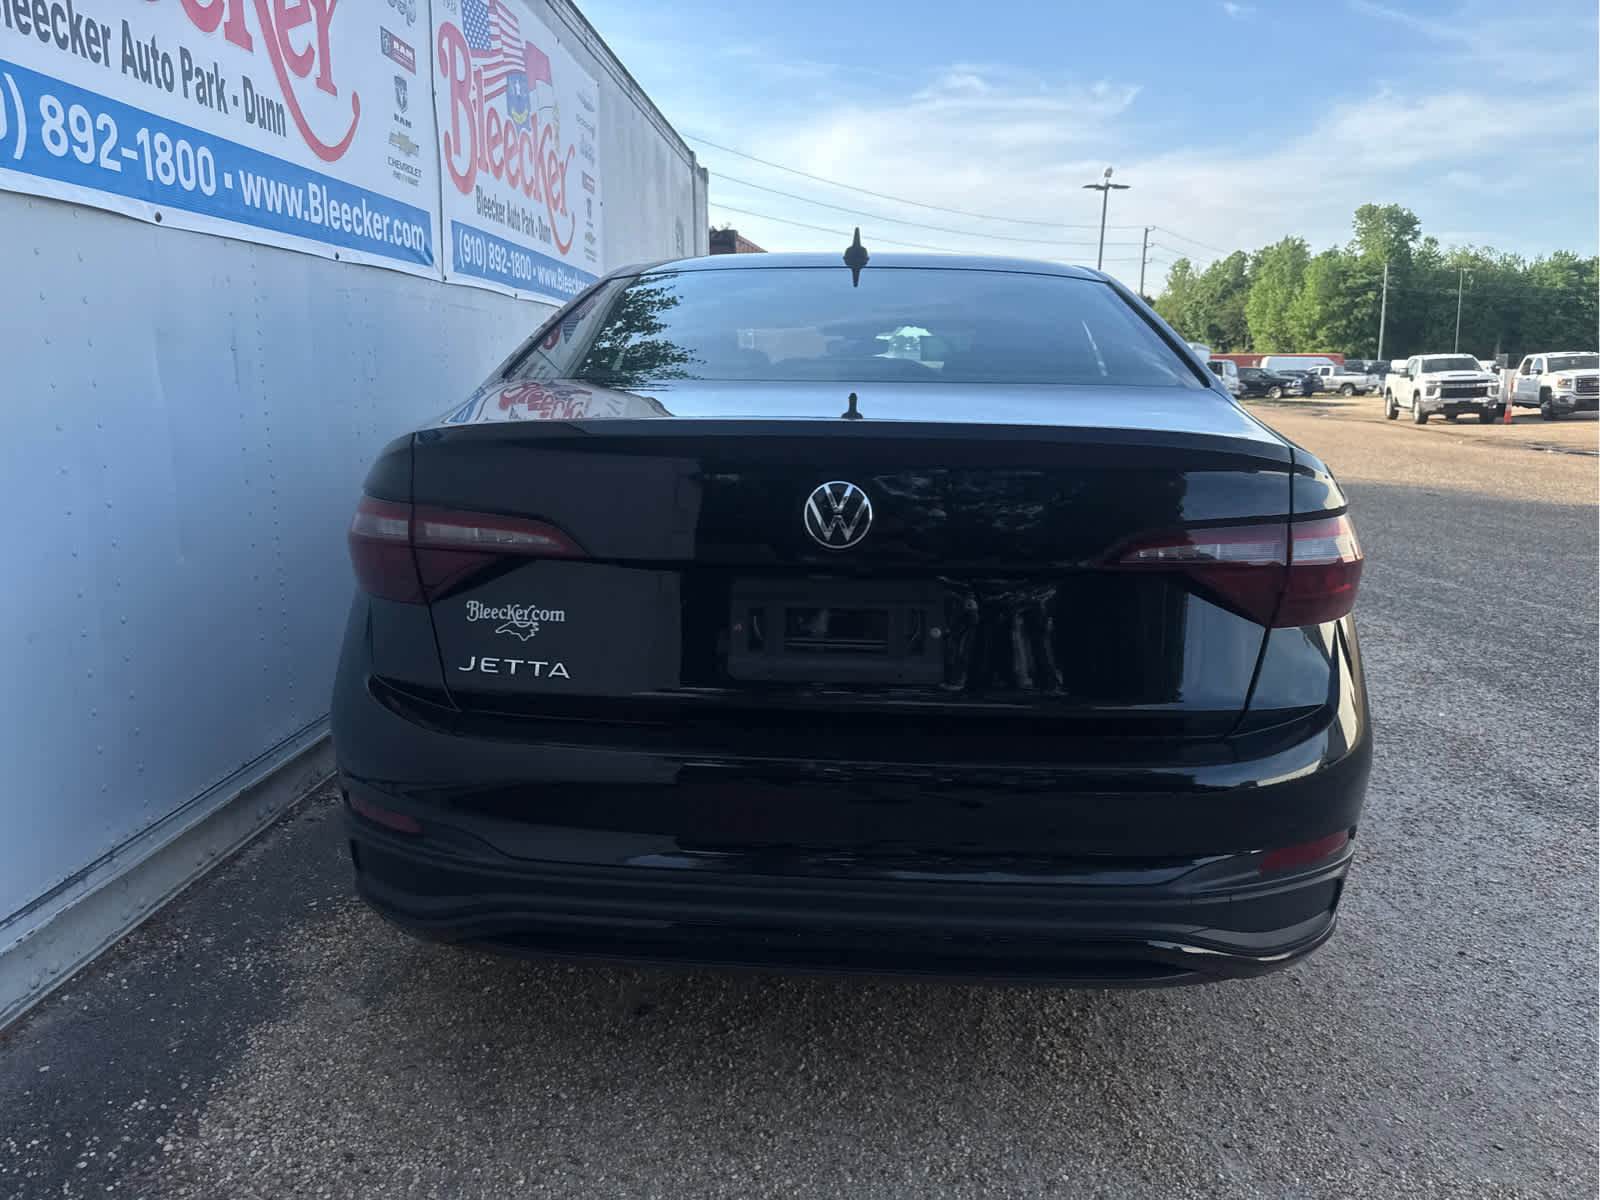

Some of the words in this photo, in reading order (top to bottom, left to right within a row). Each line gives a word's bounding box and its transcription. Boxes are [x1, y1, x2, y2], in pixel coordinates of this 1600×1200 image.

[121, 19, 175, 93] Auto
[179, 46, 229, 115] Park
[242, 75, 287, 138] Dunn
[39, 94, 218, 197] 892-1800
[238, 169, 425, 252] www.Bleecker.com
[438, 21, 574, 255] Bleecker
[475, 184, 506, 225] Bleecker
[522, 207, 537, 238] Park
[459, 229, 487, 273] (910)
[488, 242, 532, 280] 892-1800
[458, 655, 571, 679] JETTA
